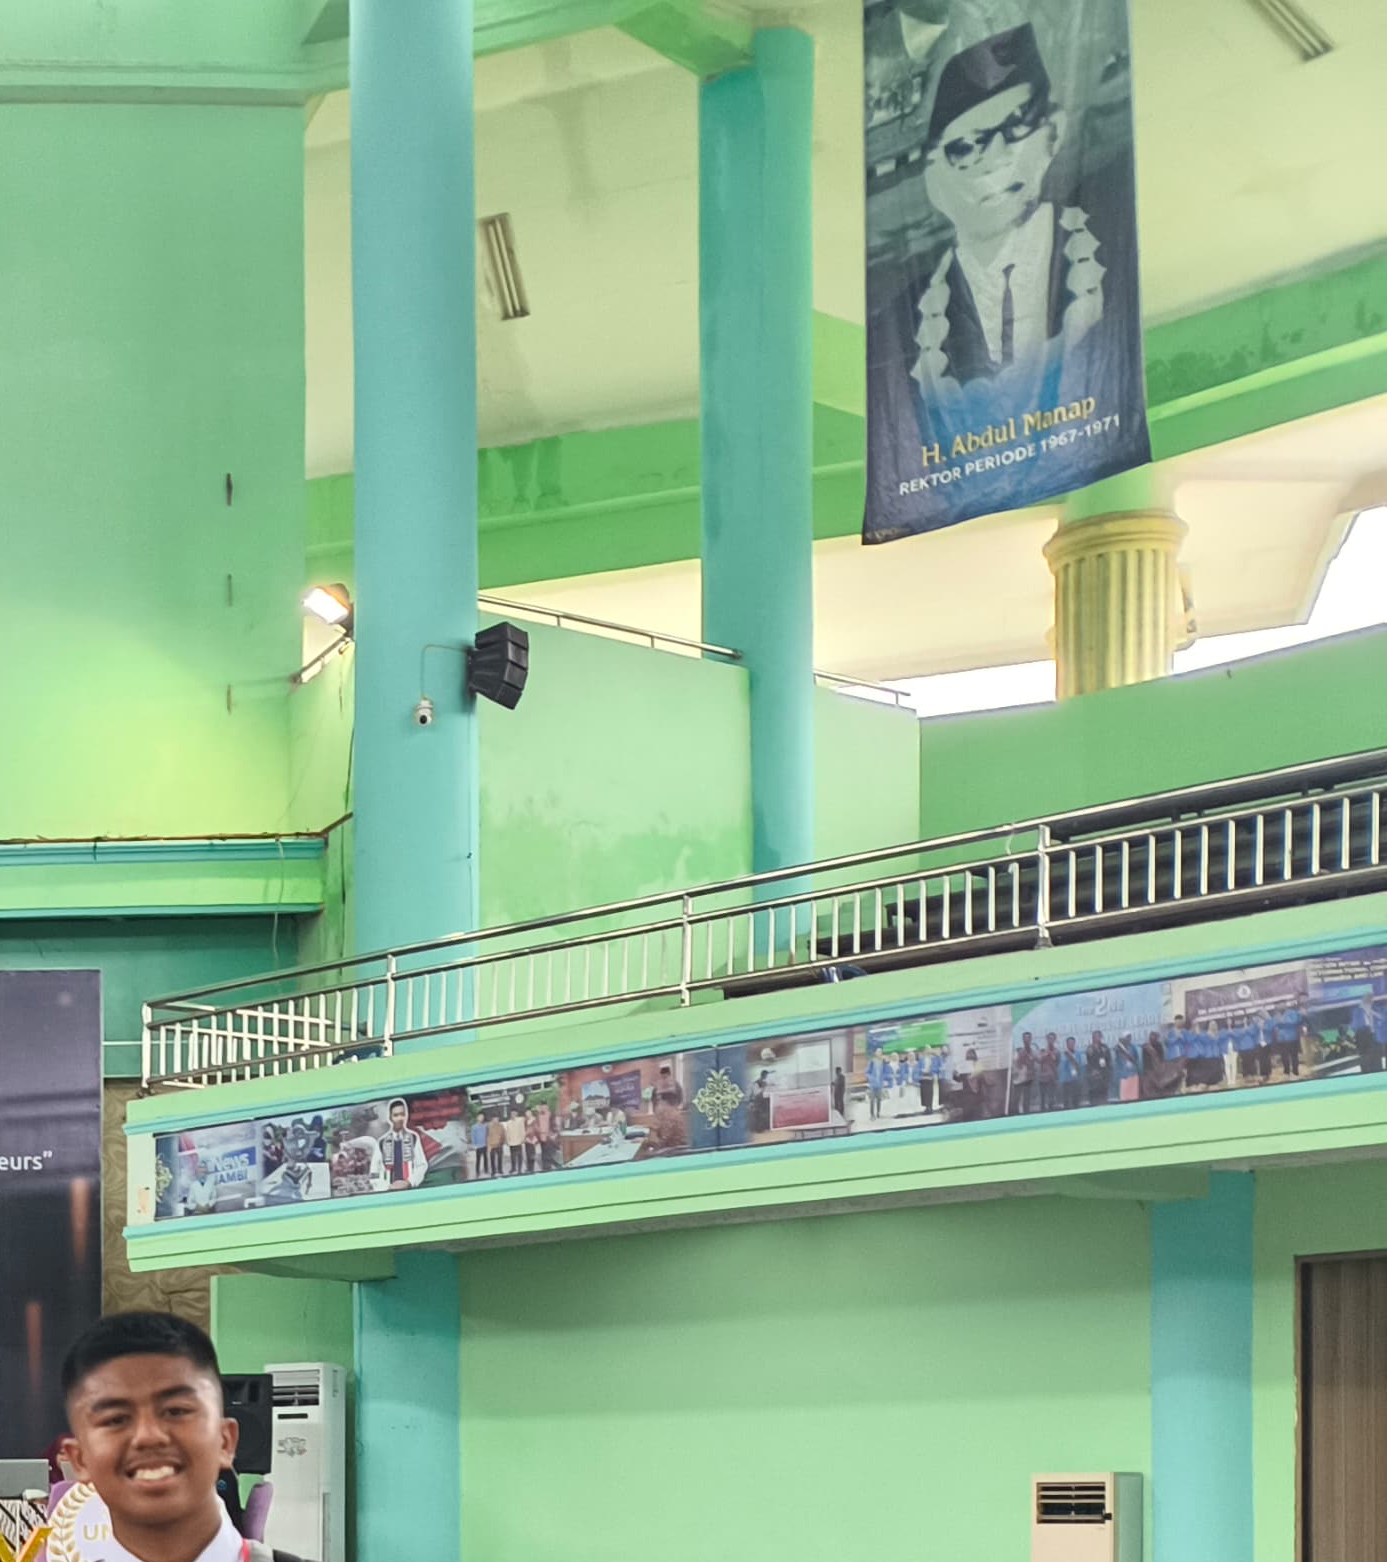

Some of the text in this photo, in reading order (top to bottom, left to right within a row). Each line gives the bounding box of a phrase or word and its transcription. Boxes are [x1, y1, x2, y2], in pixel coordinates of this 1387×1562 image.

[899, 413, 1120, 495] REKTOR PERIODE 1967-1971
[921, 397, 1096, 467] H. Abdul Manap
